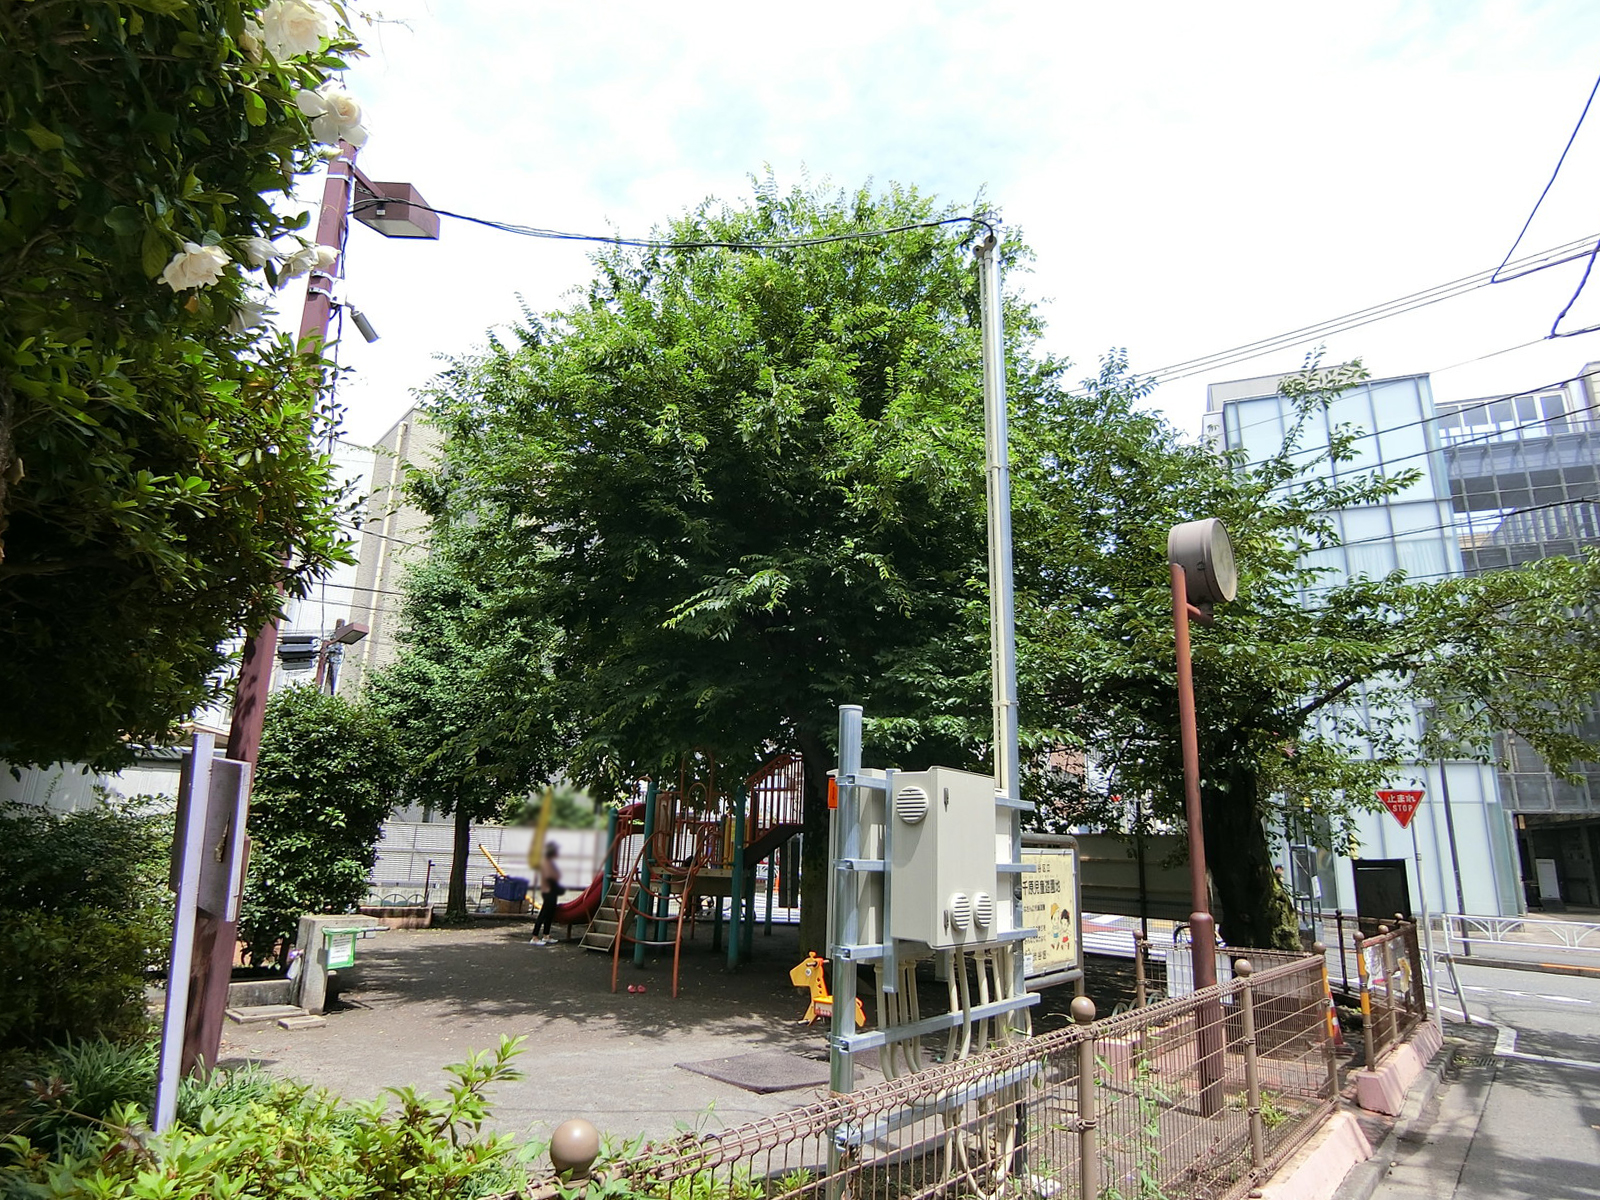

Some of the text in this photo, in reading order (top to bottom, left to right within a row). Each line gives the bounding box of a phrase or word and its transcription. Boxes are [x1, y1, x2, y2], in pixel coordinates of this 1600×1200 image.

[1387, 794, 1416, 802] 止まれ
[1392, 804, 1413, 812] STOP
